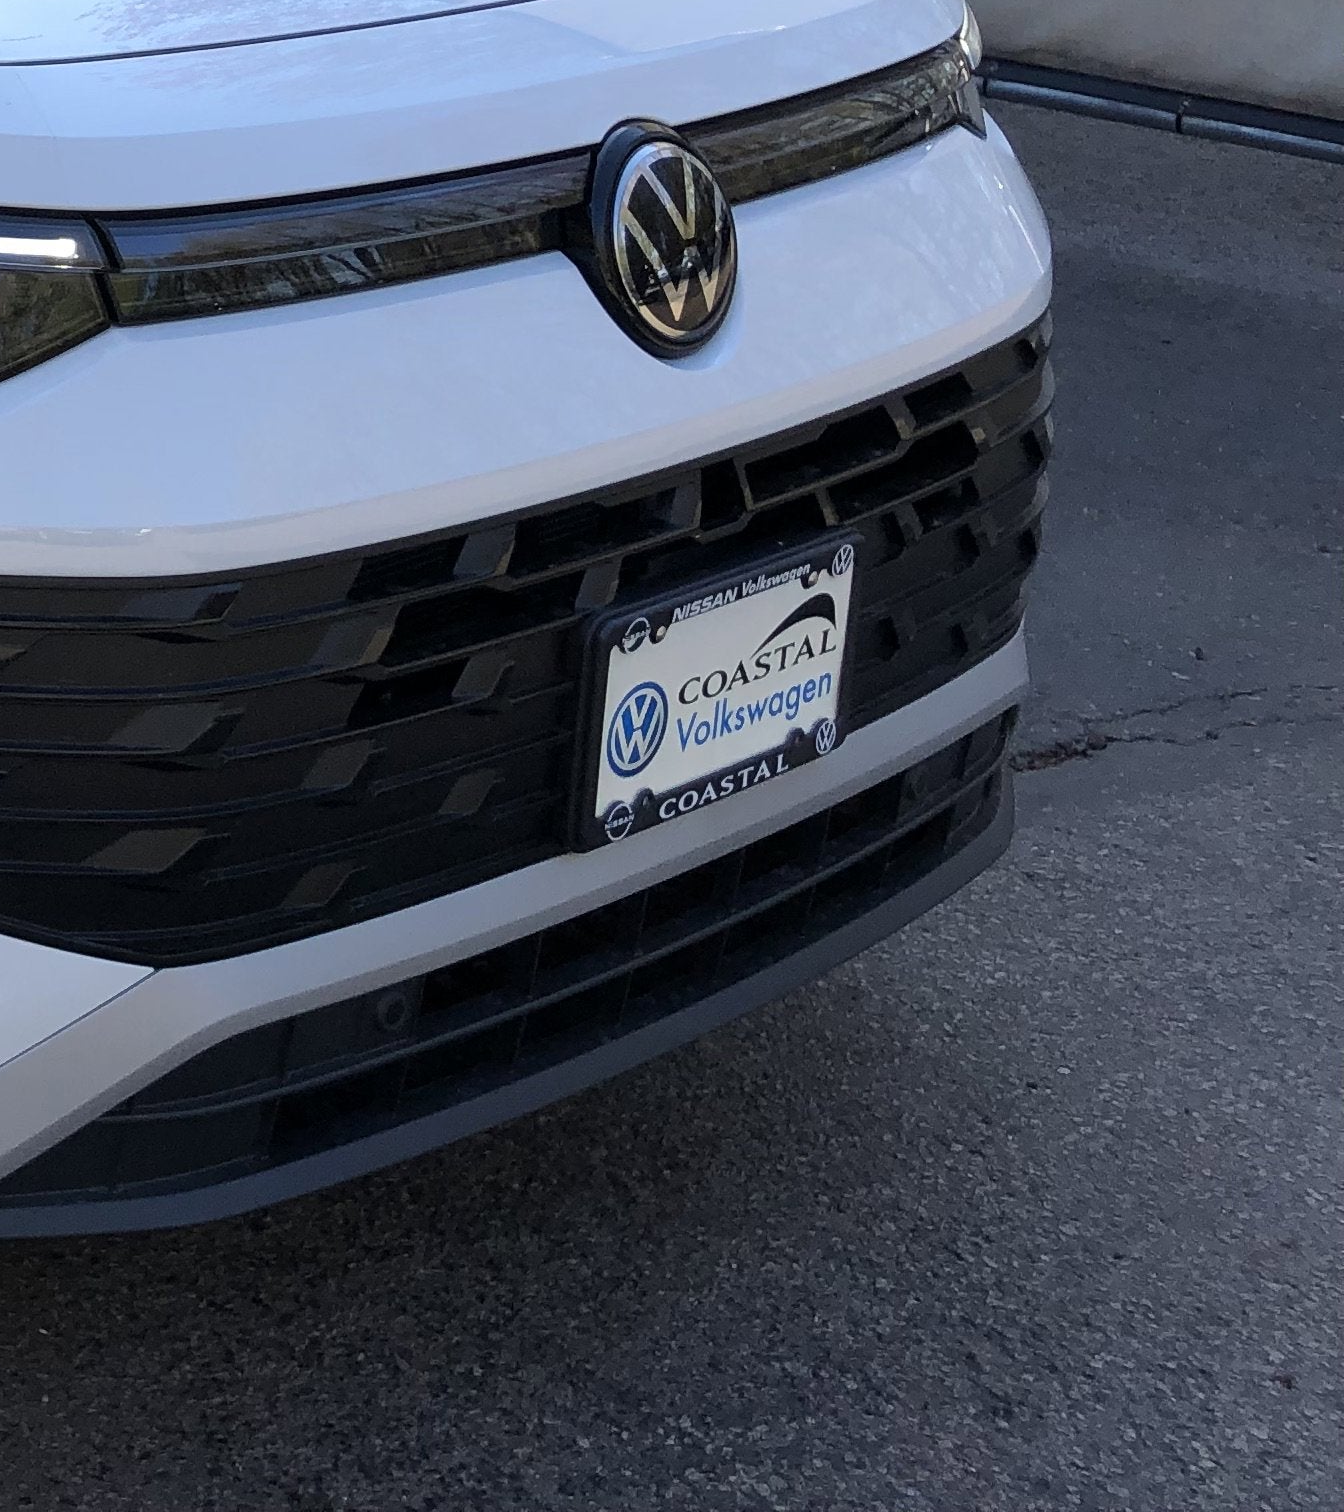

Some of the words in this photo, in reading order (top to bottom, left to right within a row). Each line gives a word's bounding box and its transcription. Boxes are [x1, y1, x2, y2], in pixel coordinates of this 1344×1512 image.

[672, 586, 739, 623] NISSAN
[742, 563, 811, 597] Volkswagen
[678, 628, 837, 705] COASTAL
[676, 672, 832, 753] Volkswagen
[659, 754, 789, 820] COASTAL
